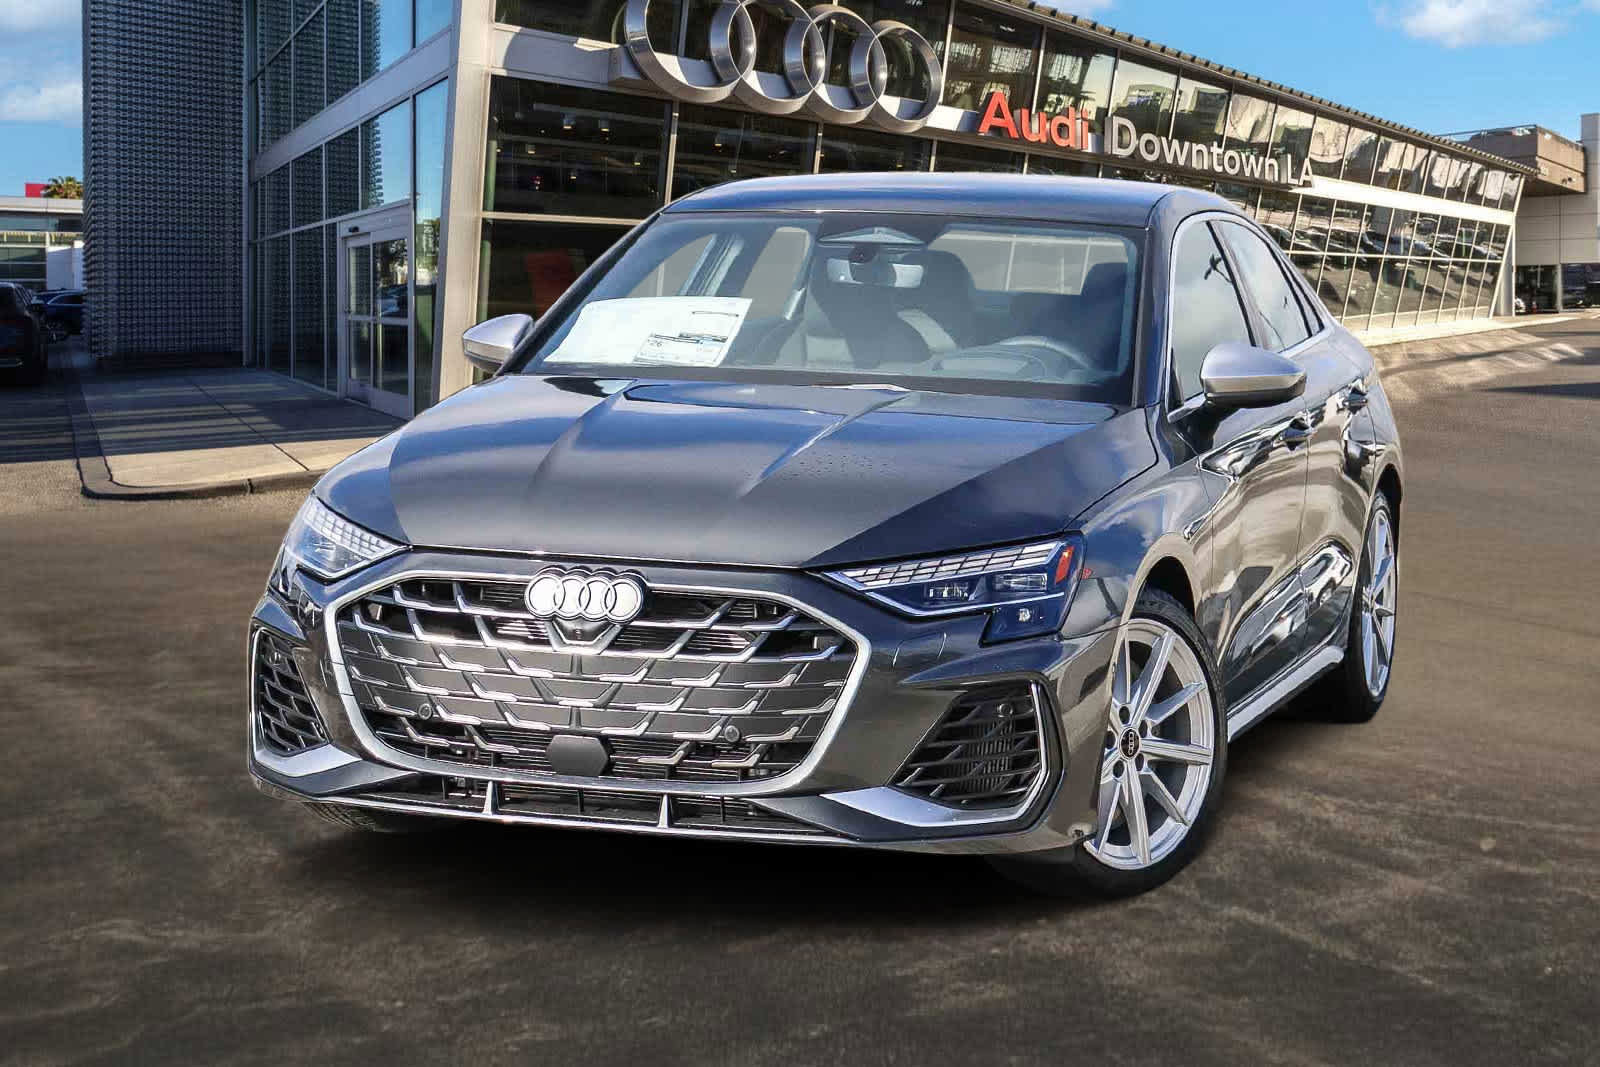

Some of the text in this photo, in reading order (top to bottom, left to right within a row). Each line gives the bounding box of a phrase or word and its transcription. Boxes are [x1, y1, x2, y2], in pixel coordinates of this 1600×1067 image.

[978, 91, 1314, 187] Audi Downtown LA
